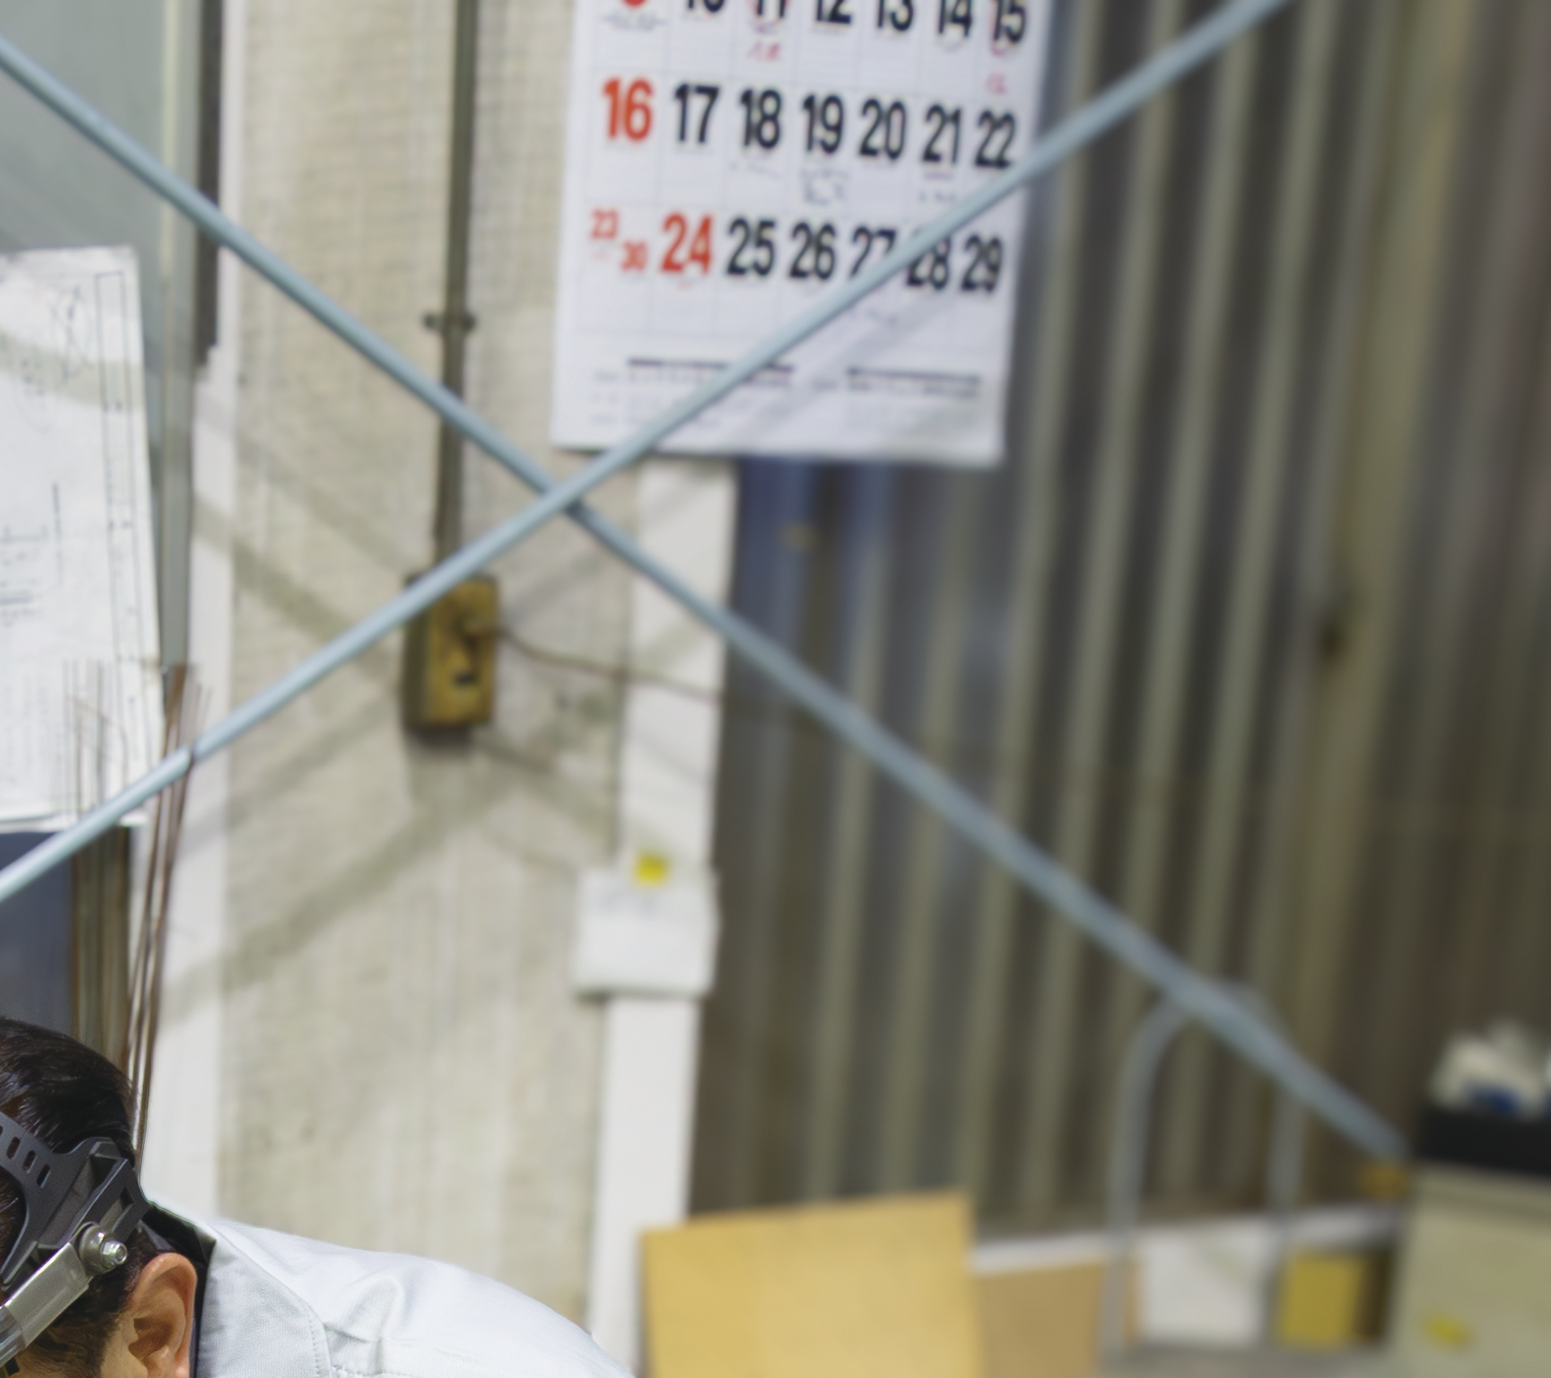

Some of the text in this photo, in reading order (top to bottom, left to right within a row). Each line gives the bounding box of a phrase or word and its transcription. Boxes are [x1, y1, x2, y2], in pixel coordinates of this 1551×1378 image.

[993, 0, 1026, 43] 15
[603, 78, 1016, 169] 16 17 18 19 20 21 22
[661, 213, 713, 274] 24
[726, 217, 776, 277] 25
[789, 222, 836, 281] 26
[961, 235, 1002, 292] 29
